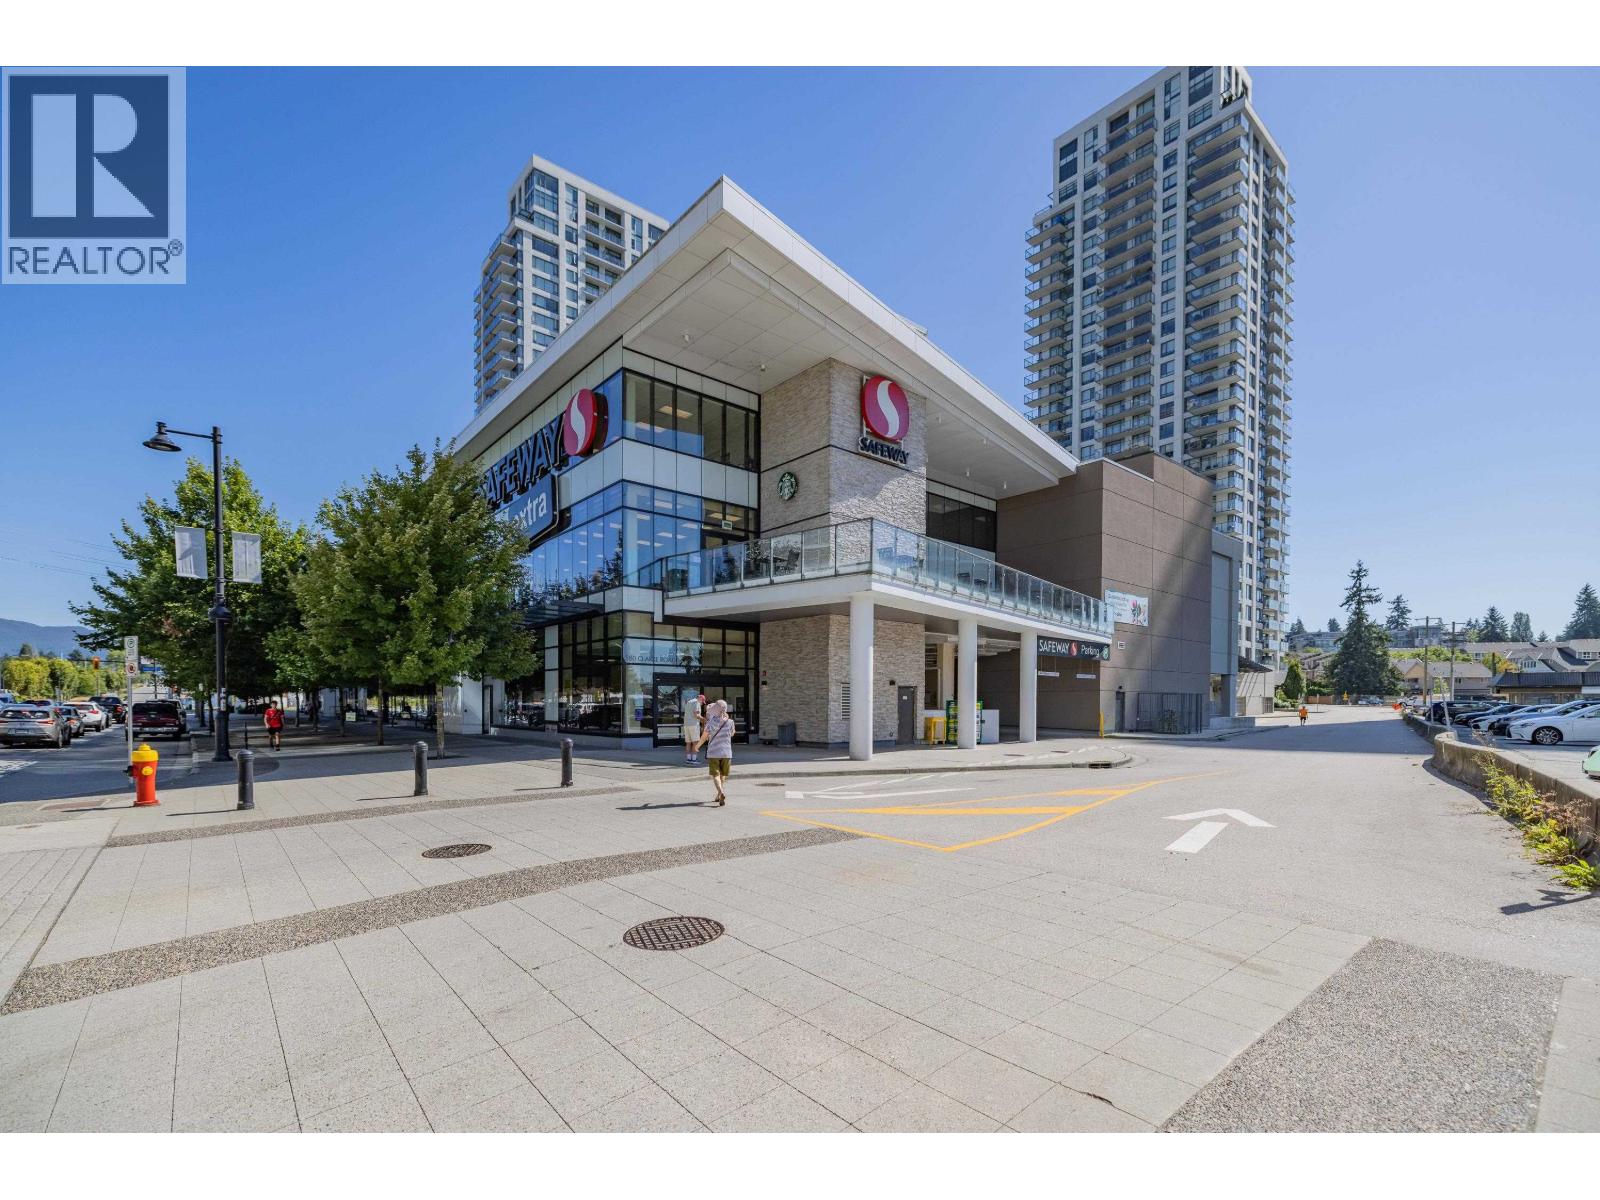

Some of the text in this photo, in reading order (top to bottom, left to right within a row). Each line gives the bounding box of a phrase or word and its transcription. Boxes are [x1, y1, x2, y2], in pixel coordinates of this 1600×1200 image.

[860, 437, 909, 464] SAFEWAY
[1039, 640, 1100, 658] SAFEWAY Parking
